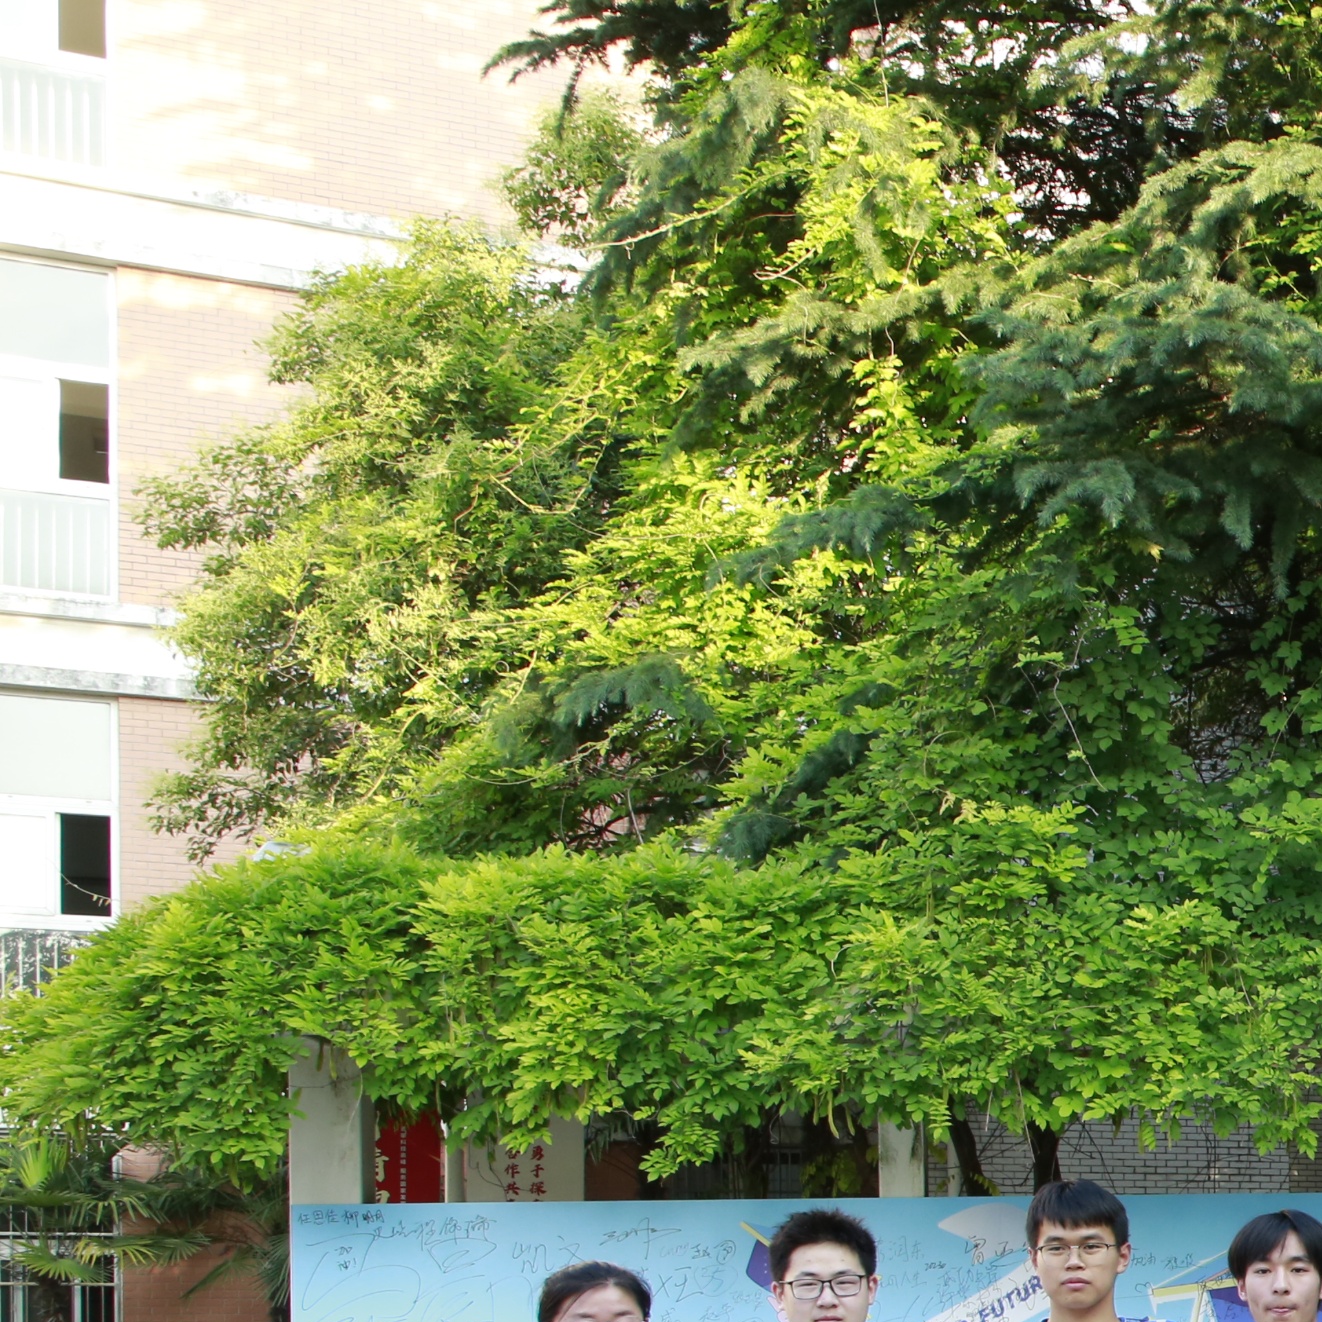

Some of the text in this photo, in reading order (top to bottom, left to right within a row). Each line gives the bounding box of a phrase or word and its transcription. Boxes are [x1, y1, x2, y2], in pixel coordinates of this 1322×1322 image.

[504, 1147, 521, 1202] 合作共
[529, 1145, 546, 1202] 勇于探
